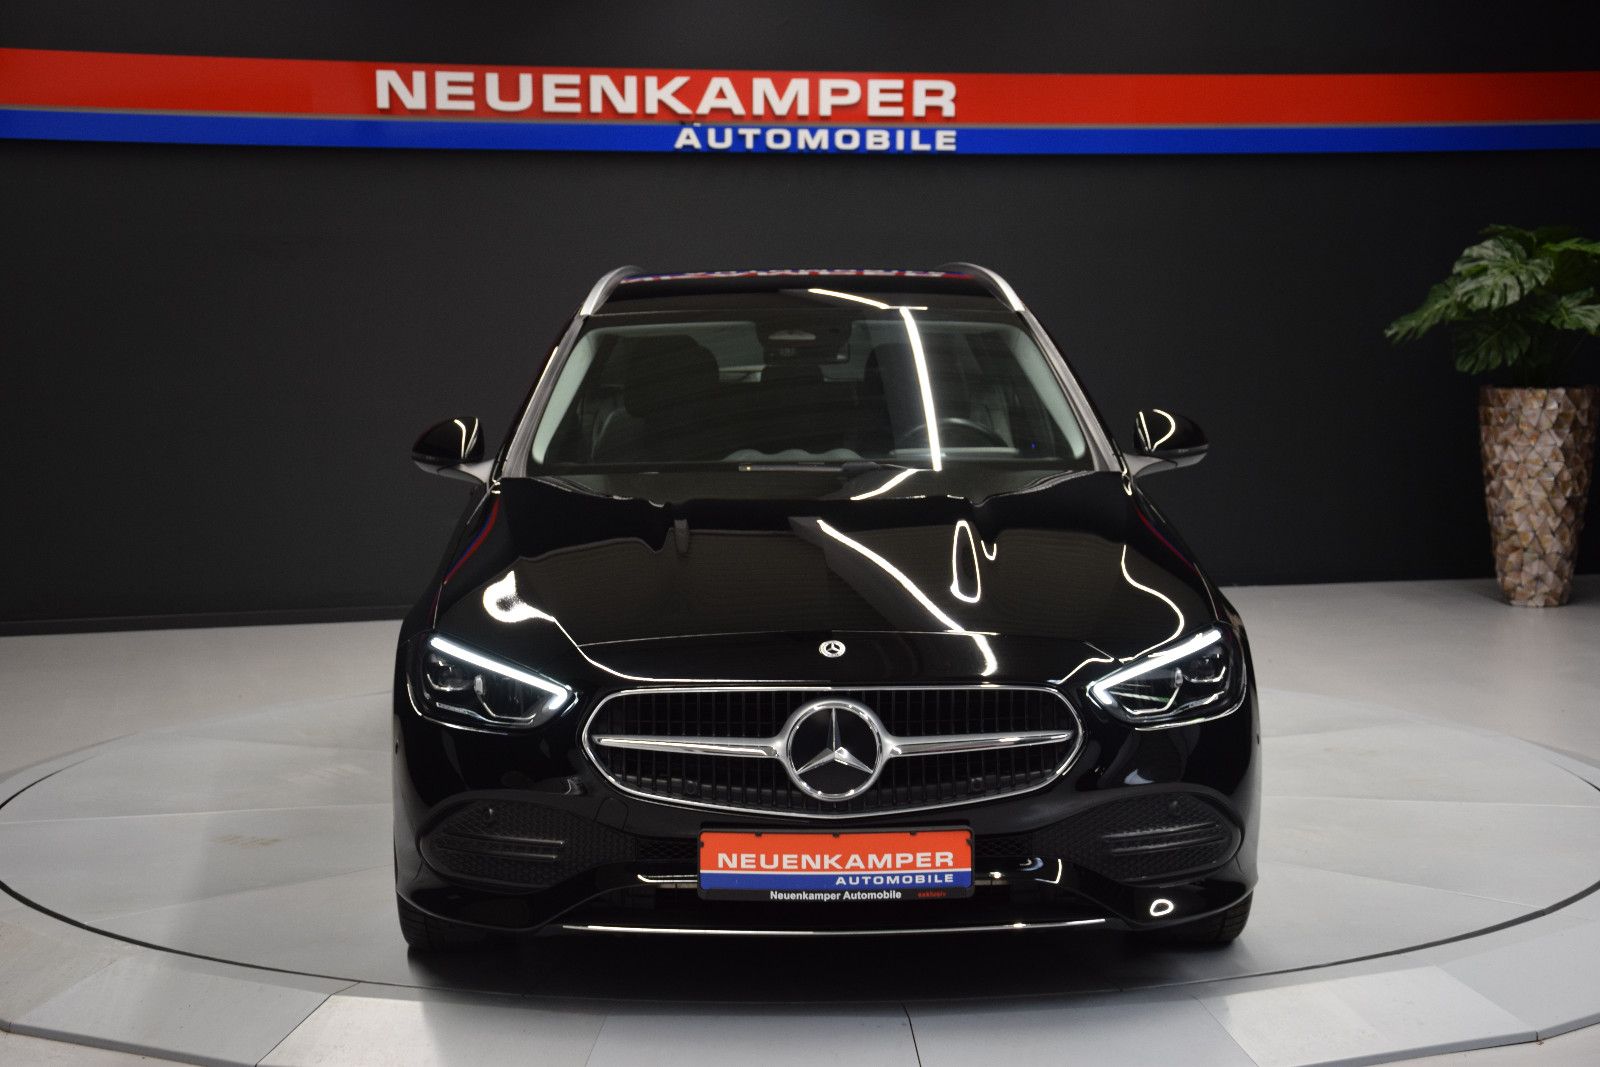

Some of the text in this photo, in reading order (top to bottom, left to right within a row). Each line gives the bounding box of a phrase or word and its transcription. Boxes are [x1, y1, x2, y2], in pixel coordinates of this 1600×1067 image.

[374, 69, 958, 118] NEUENKAMPER
[674, 127, 958, 152] AUTOMOBILE
[717, 851, 954, 870] NEUENKAMPER
[835, 873, 954, 886] AUTOMOBILE
[769, 890, 841, 902] Neuenkamper
[843, 890, 902, 900] Automobile
